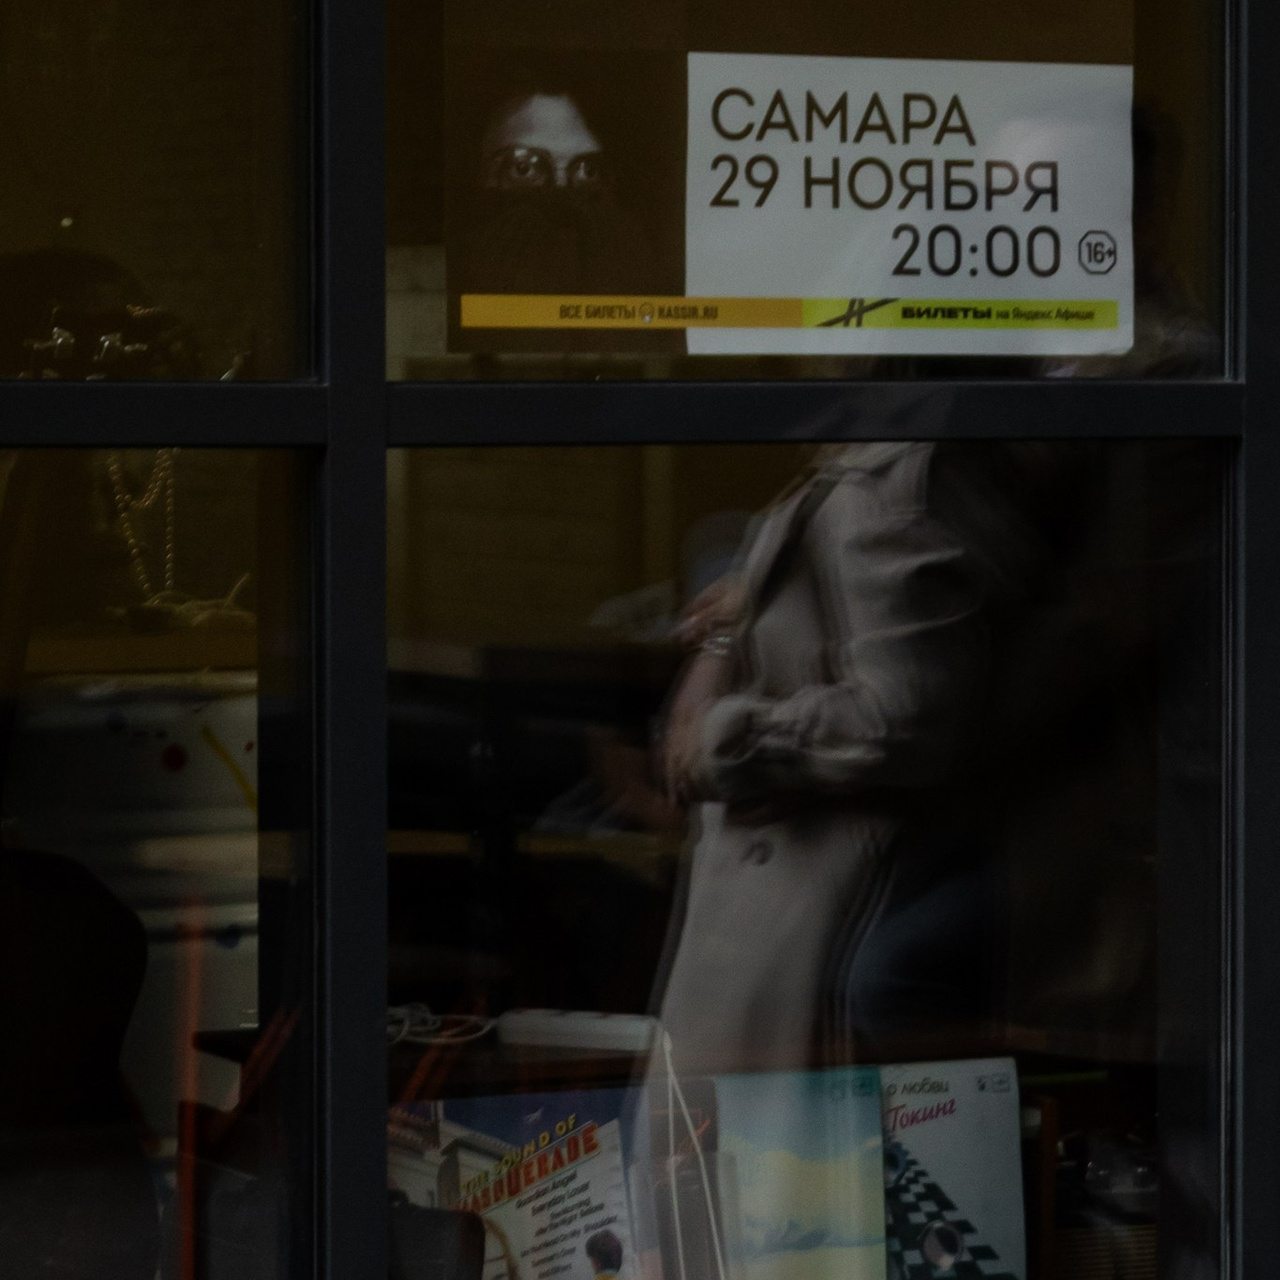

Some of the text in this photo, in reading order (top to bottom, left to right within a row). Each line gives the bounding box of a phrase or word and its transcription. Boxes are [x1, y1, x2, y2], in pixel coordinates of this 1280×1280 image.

[711, 86, 977, 147] САМАРА
[709, 153, 1060, 212] 29 НОЯБРЯ
[891, 223, 1117, 278] 20:00 16+
[559, 304, 582, 319] ВСЕ
[585, 304, 637, 319] БИЛЕТЫ
[901, 306, 992, 320] БИЛЕТЫ
[995, 310, 1010, 321] на
[555, 1113, 577, 1136] OF
[888, 1098, 957, 1132] Токинг
